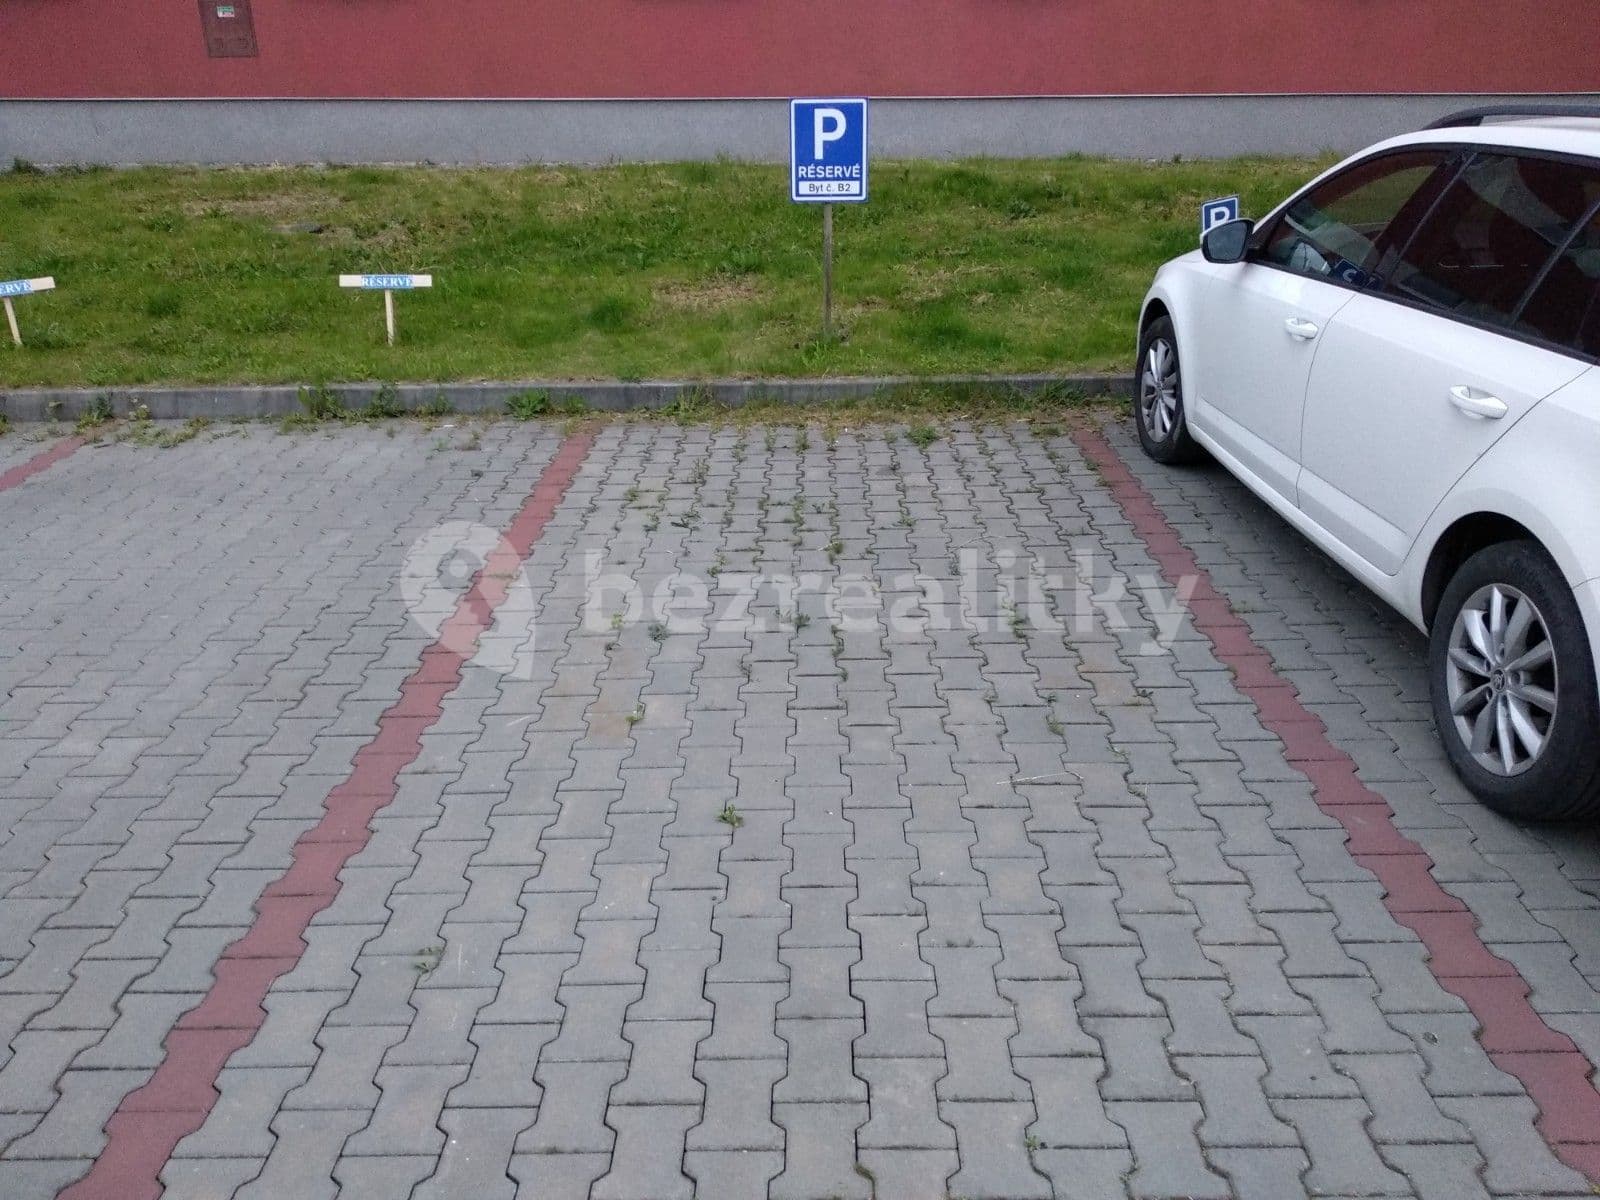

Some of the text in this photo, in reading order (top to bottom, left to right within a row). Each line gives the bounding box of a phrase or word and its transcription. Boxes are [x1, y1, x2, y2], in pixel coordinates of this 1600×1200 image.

[814, 108, 847, 160] P
[798, 163, 861, 178] RÉSERVÉ
[808, 183, 824, 193] Byt
[838, 183, 851, 192] B2
[1210, 206, 1230, 229] P
